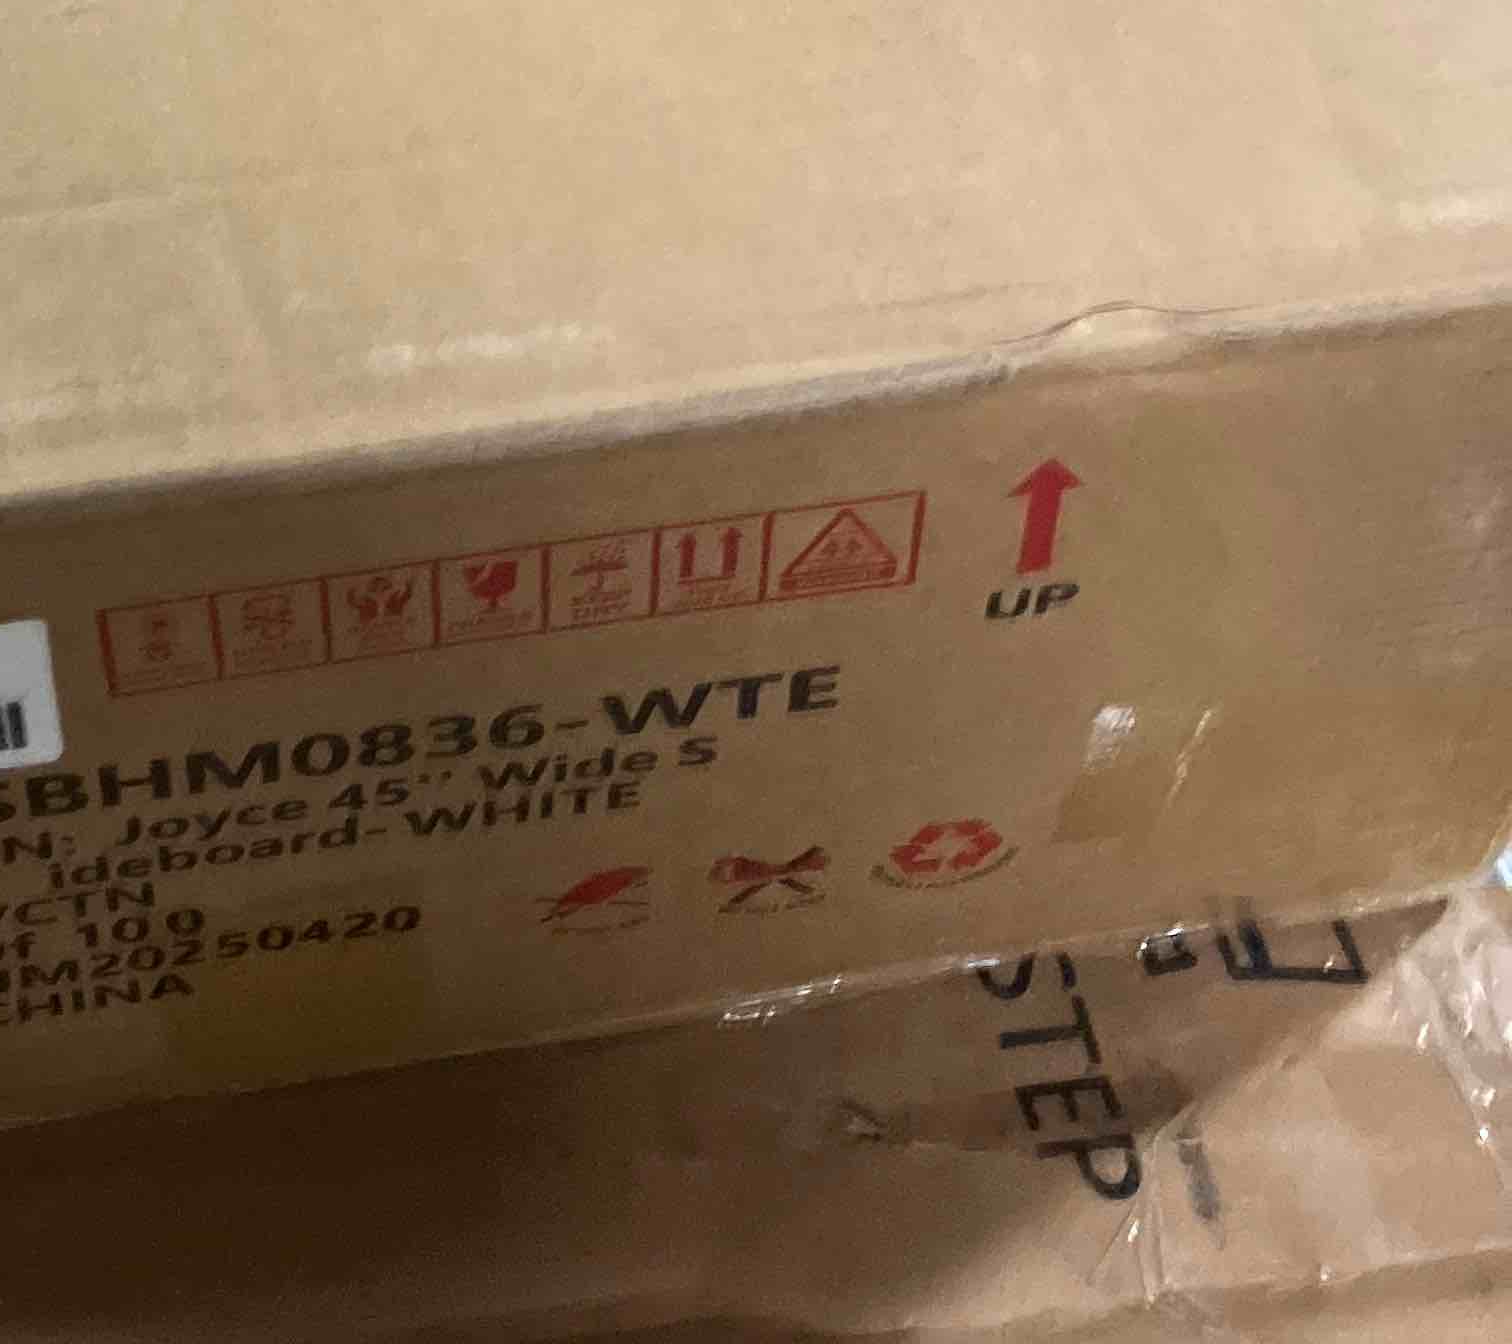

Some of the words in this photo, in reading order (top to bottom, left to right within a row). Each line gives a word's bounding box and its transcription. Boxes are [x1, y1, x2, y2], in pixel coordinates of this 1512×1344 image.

[985, 583, 1080, 619] UP
[115, 798, 308, 849] Joyce
[478, 745, 660, 792] Wide
[677, 735, 719, 769] S
